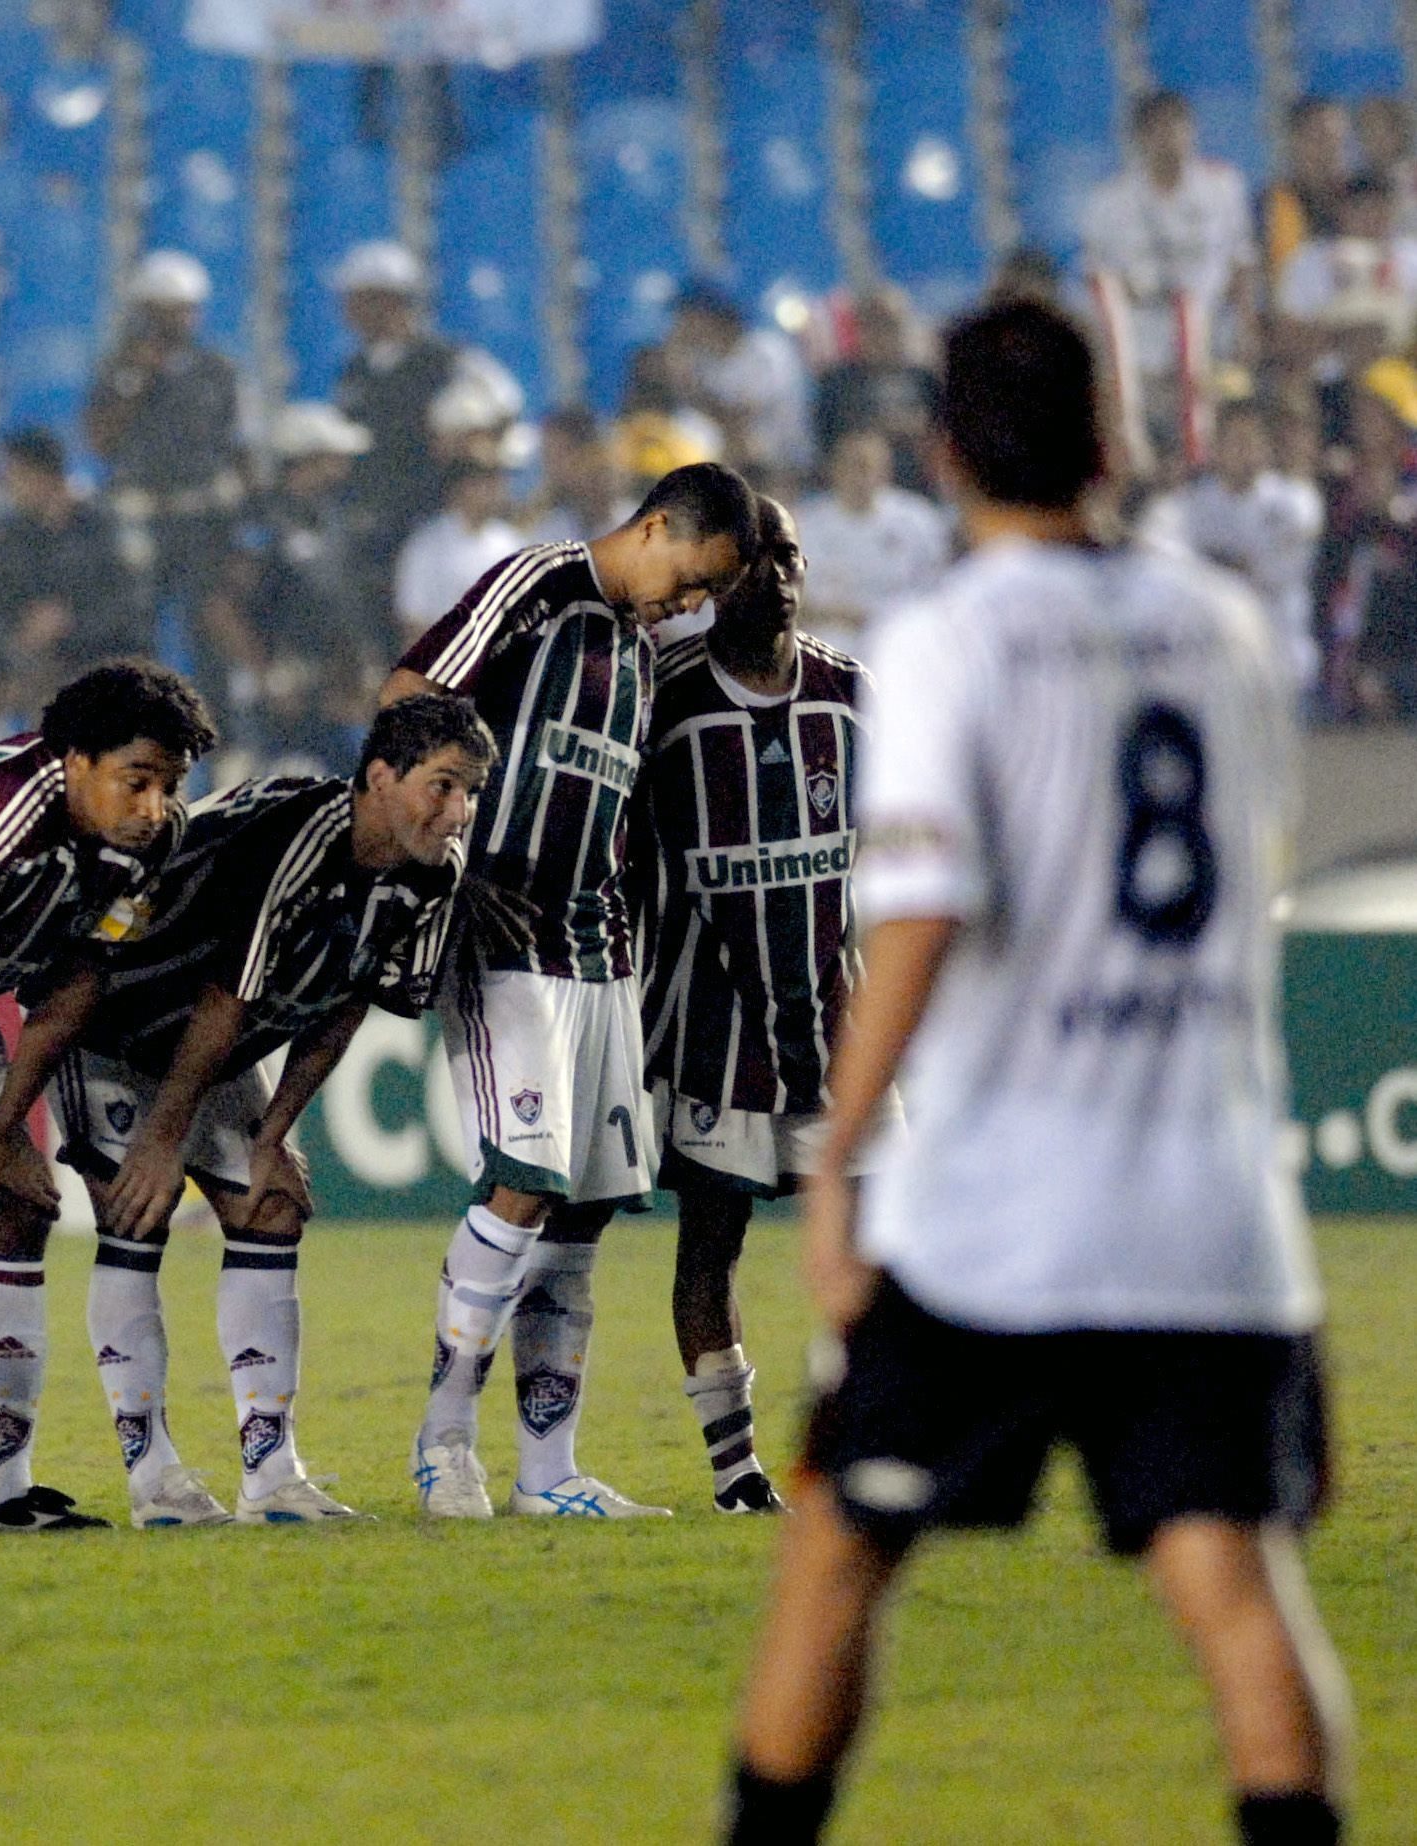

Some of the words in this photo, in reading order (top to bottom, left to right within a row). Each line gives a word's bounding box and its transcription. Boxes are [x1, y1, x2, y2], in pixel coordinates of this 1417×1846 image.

[546, 728, 638, 791] Unime
[1116, 697, 1219, 948] 8
[696, 835, 850, 888] Unimed
